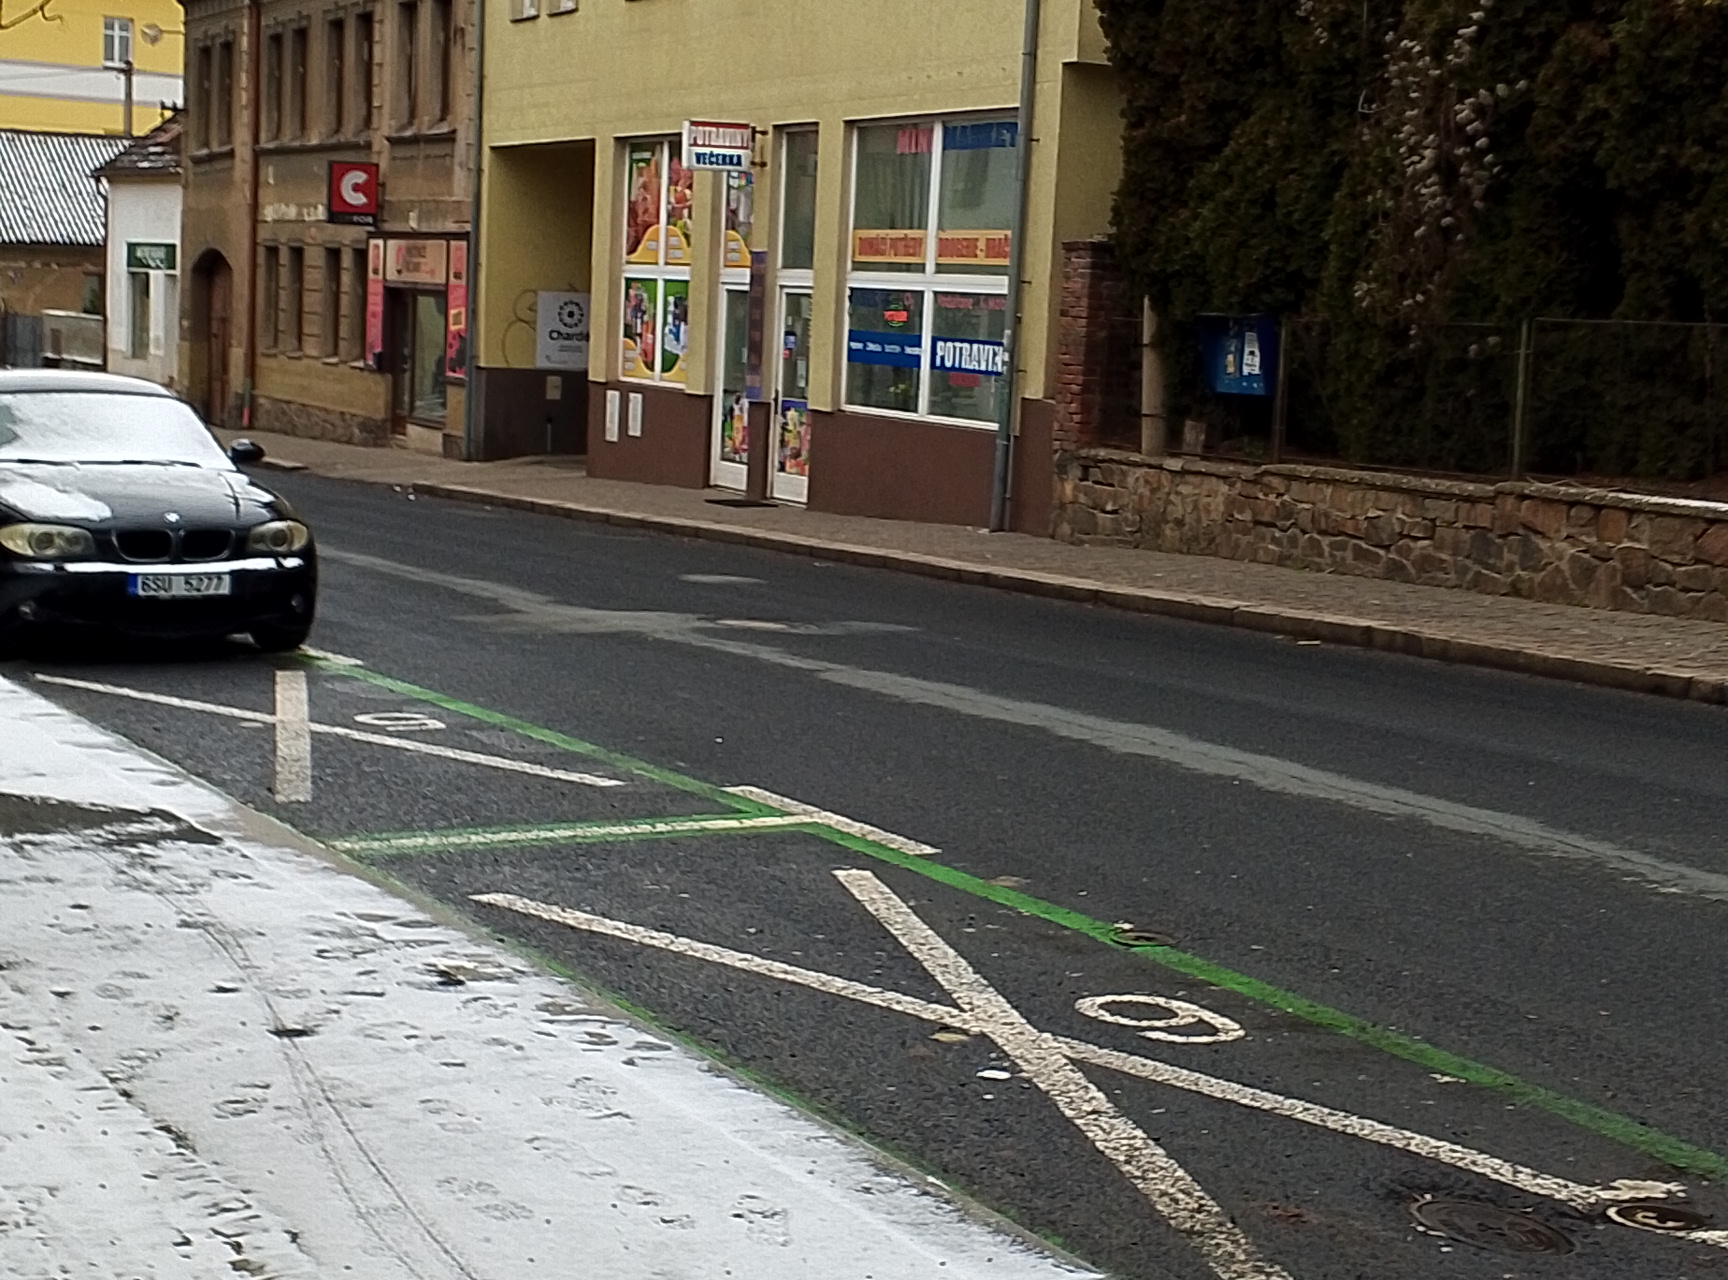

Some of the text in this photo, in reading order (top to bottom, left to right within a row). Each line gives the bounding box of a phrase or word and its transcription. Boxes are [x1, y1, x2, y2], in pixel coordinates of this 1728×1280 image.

[689, 126, 749, 147] POTRAVINY
[694, 150, 742, 167] VEČERKA
[341, 169, 369, 207] C
[935, 340, 1004, 373] POTRAVIN
